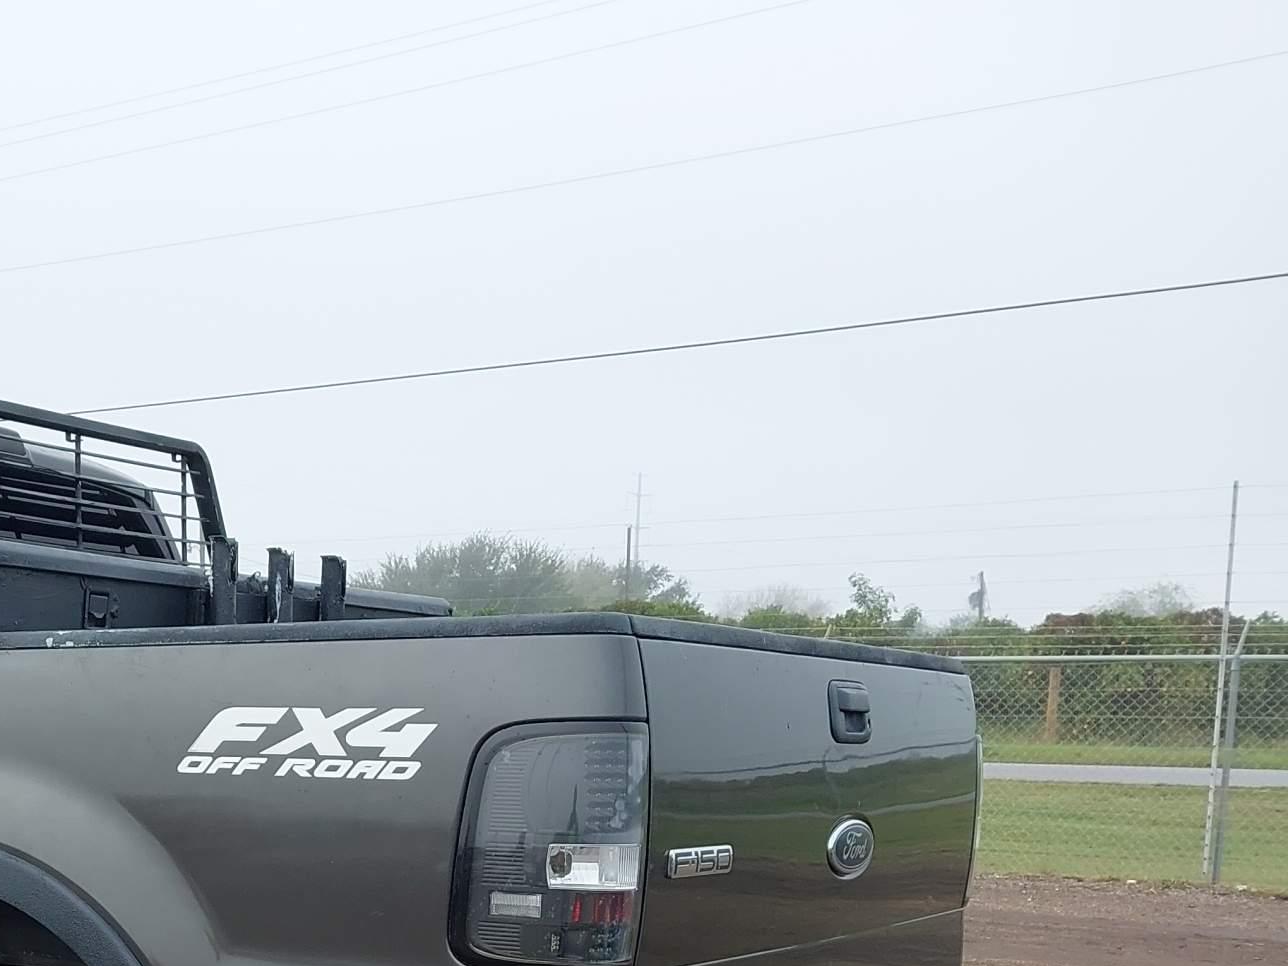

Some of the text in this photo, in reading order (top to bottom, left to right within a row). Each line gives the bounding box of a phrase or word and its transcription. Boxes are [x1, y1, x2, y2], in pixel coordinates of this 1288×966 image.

[187, 706, 439, 758] FX4
[176, 755, 422, 781] OFF ROAD
[842, 831, 868, 860] Ford
